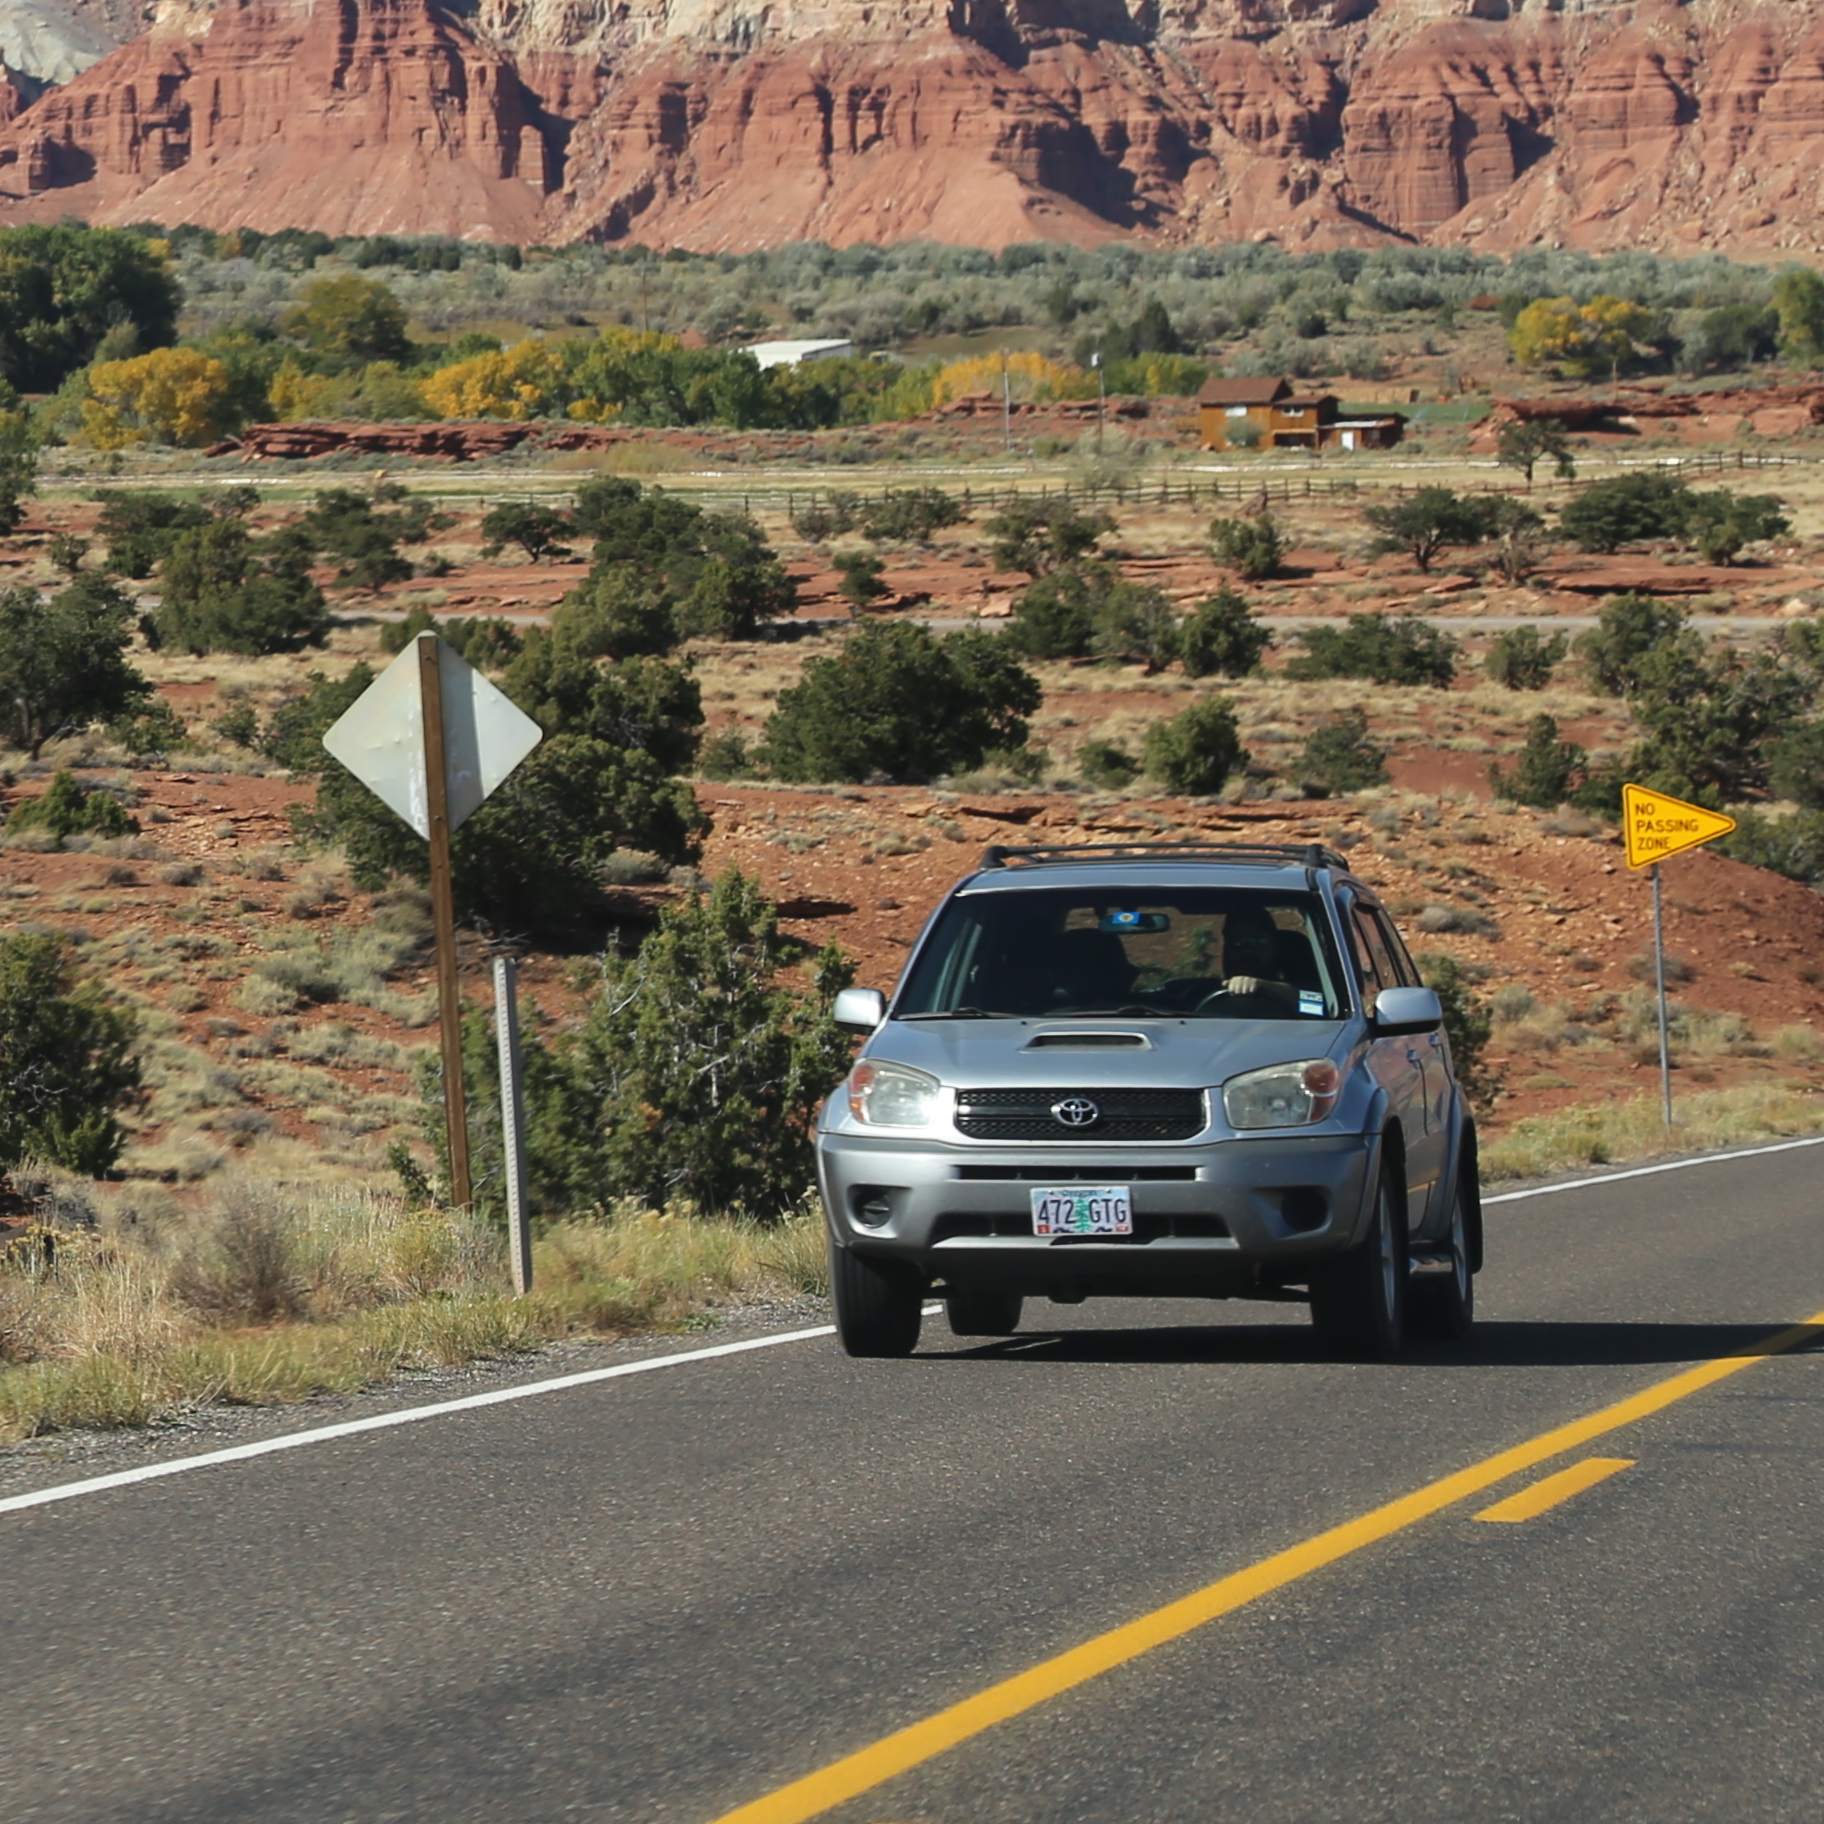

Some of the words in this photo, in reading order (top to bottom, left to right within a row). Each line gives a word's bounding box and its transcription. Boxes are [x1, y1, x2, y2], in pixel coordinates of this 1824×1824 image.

[1635, 803, 1655, 816] NO
[1636, 819, 1699, 832] PASSING
[1637, 837, 1671, 850] ZONE
[1038, 1199, 1076, 1224] 472
[1088, 1199, 1126, 1223] GTG
